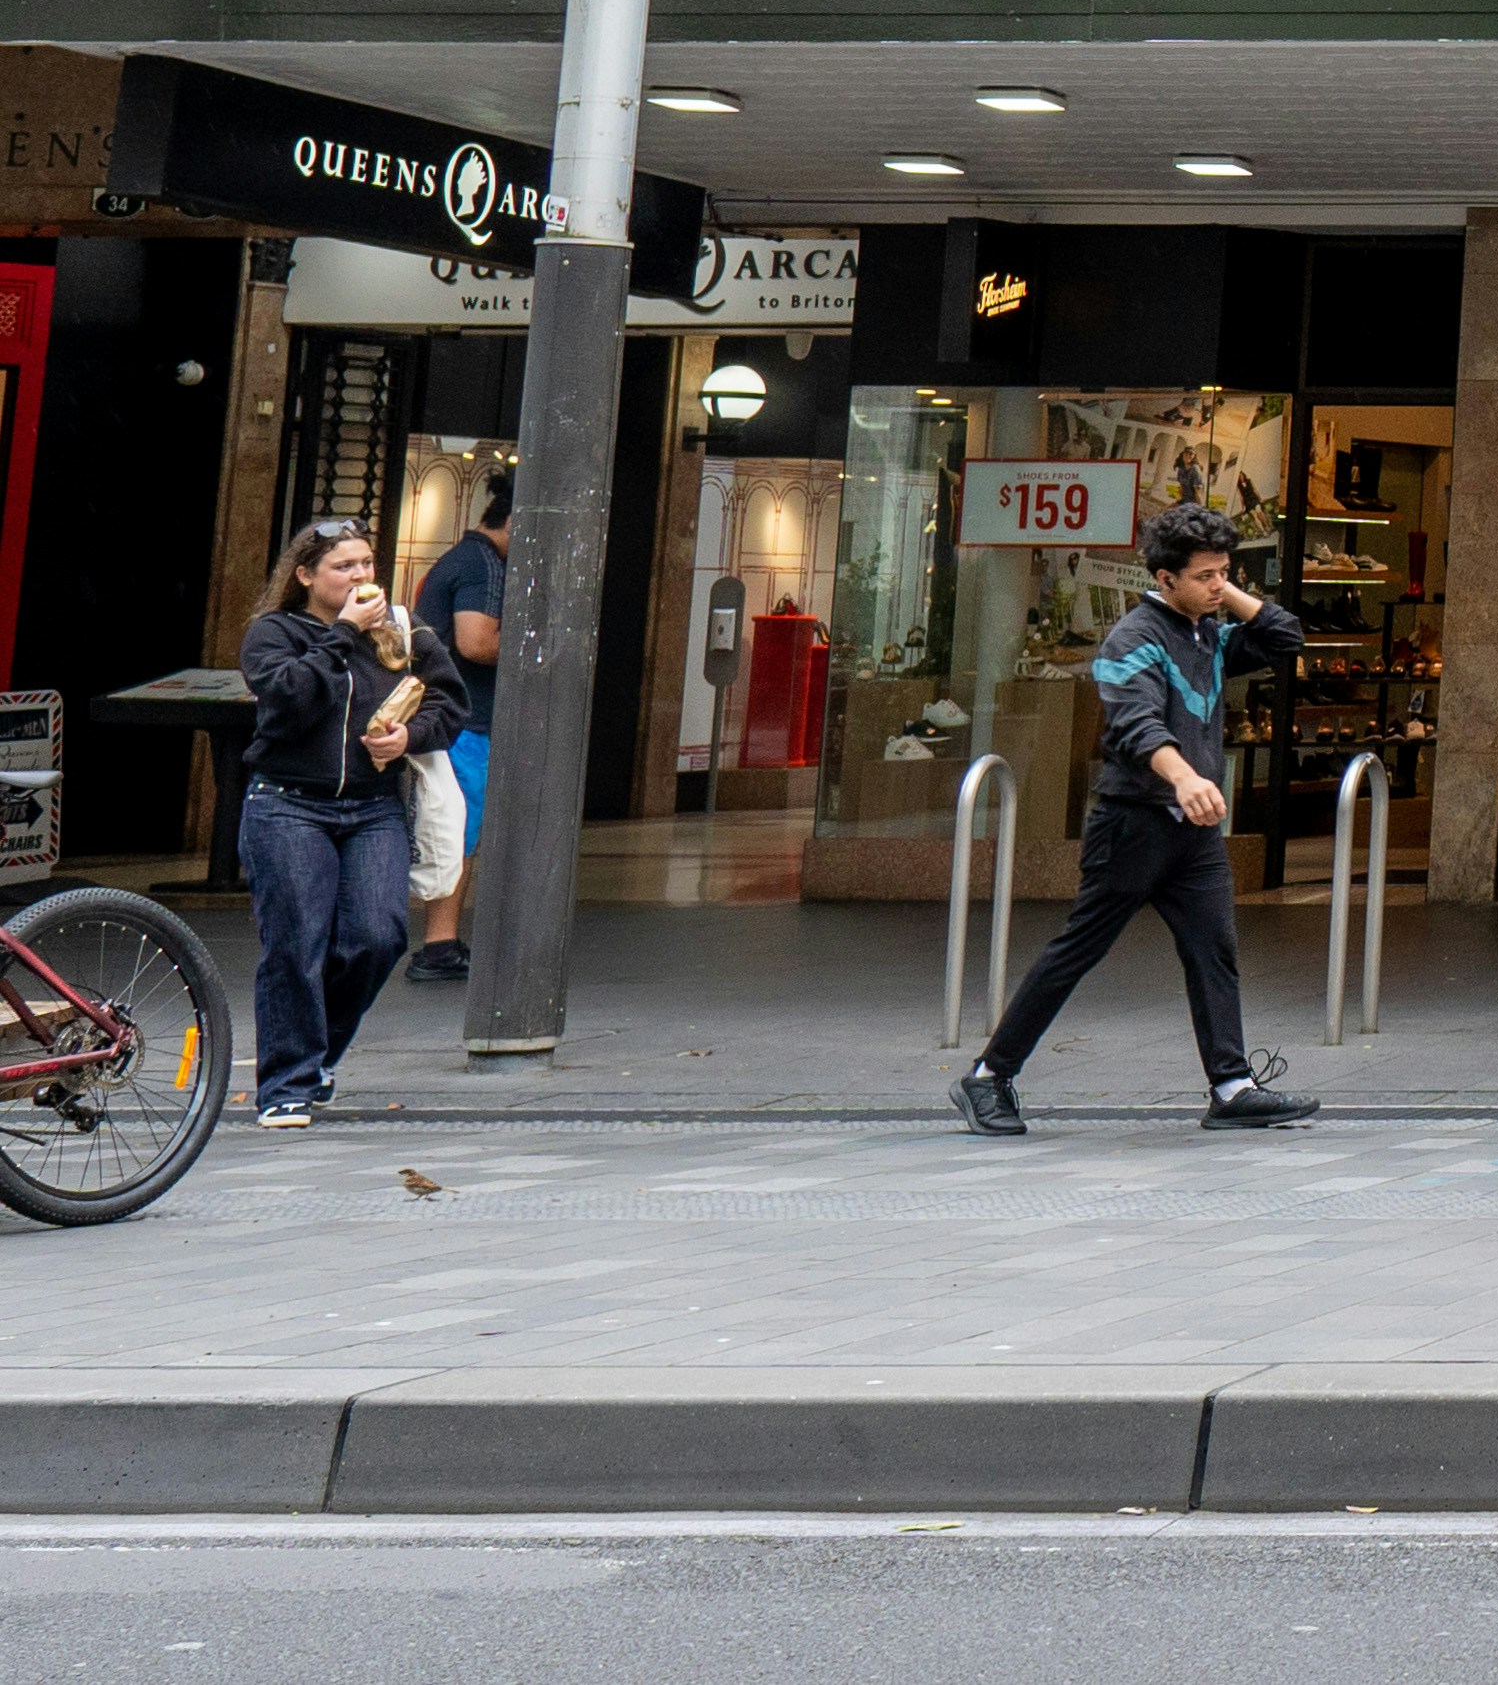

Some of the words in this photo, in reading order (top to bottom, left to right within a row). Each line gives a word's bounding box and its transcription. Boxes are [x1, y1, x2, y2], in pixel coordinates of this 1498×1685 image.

[294, 135, 438, 198] QUEENS
[107, 195, 129, 213] 34
[461, 295, 512, 312] Walk
[758, 294, 780, 309] to
[1016, 472, 1049, 481] SHOES
[1052, 472, 1080, 481] FROM
[999, 482, 1090, 531] $159
[1092, 563, 1115, 573] YOUR
[1116, 577, 1135, 586] OUR
